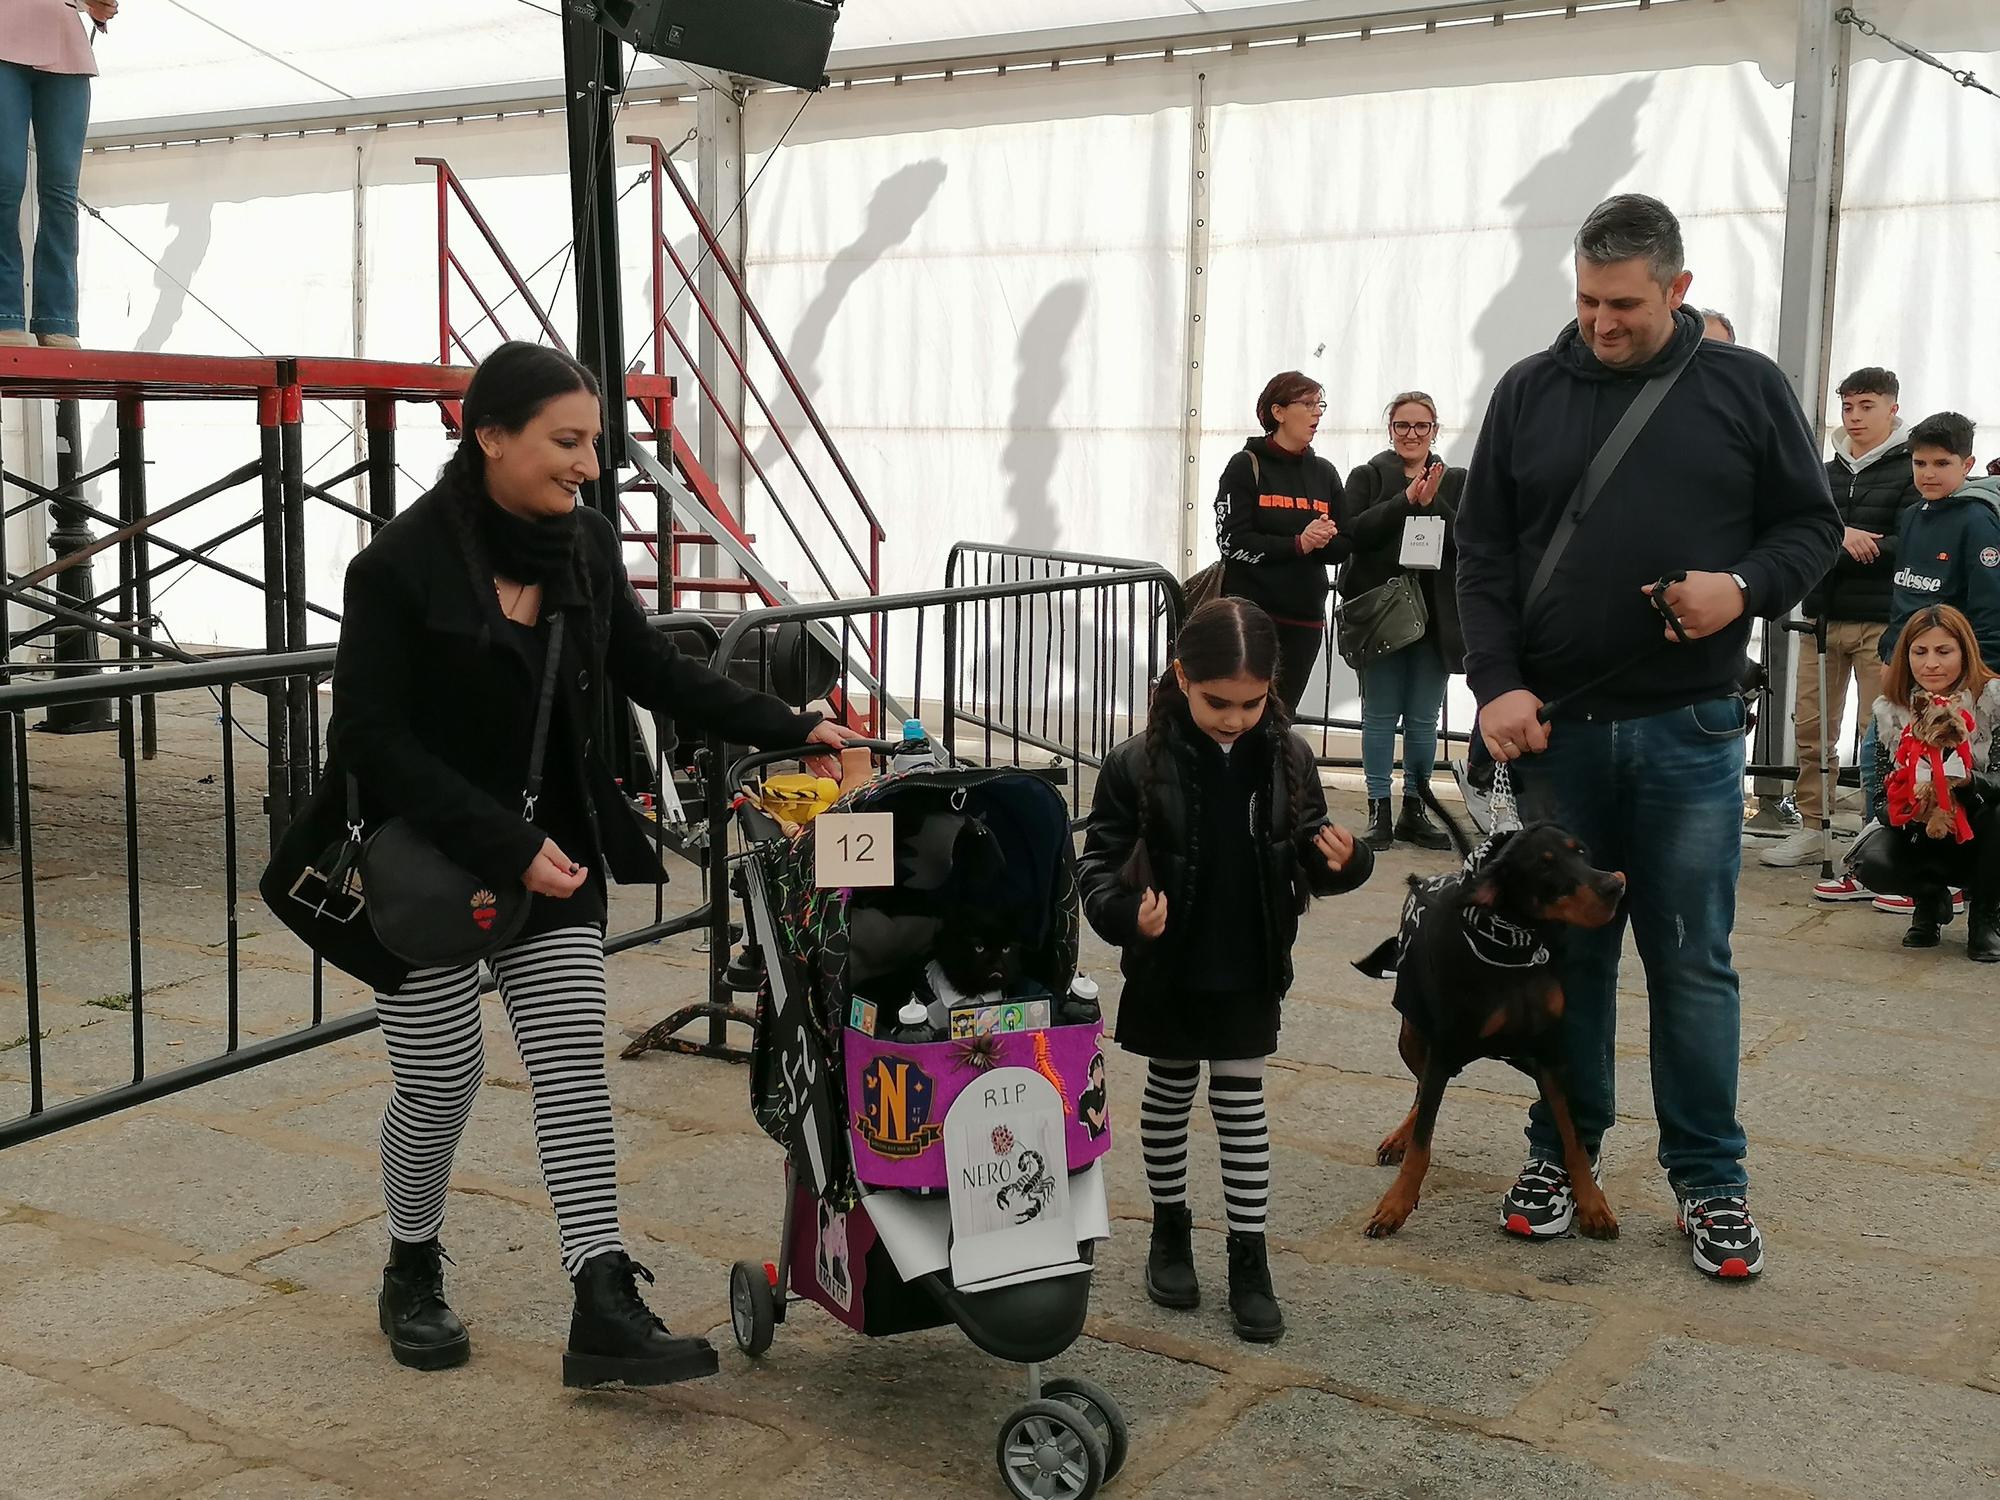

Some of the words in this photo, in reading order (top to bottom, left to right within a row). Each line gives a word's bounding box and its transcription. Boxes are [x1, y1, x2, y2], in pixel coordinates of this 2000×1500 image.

[836, 833, 875, 862] 12
[878, 1059, 910, 1141] N
[963, 1159, 1012, 1190] NERO
